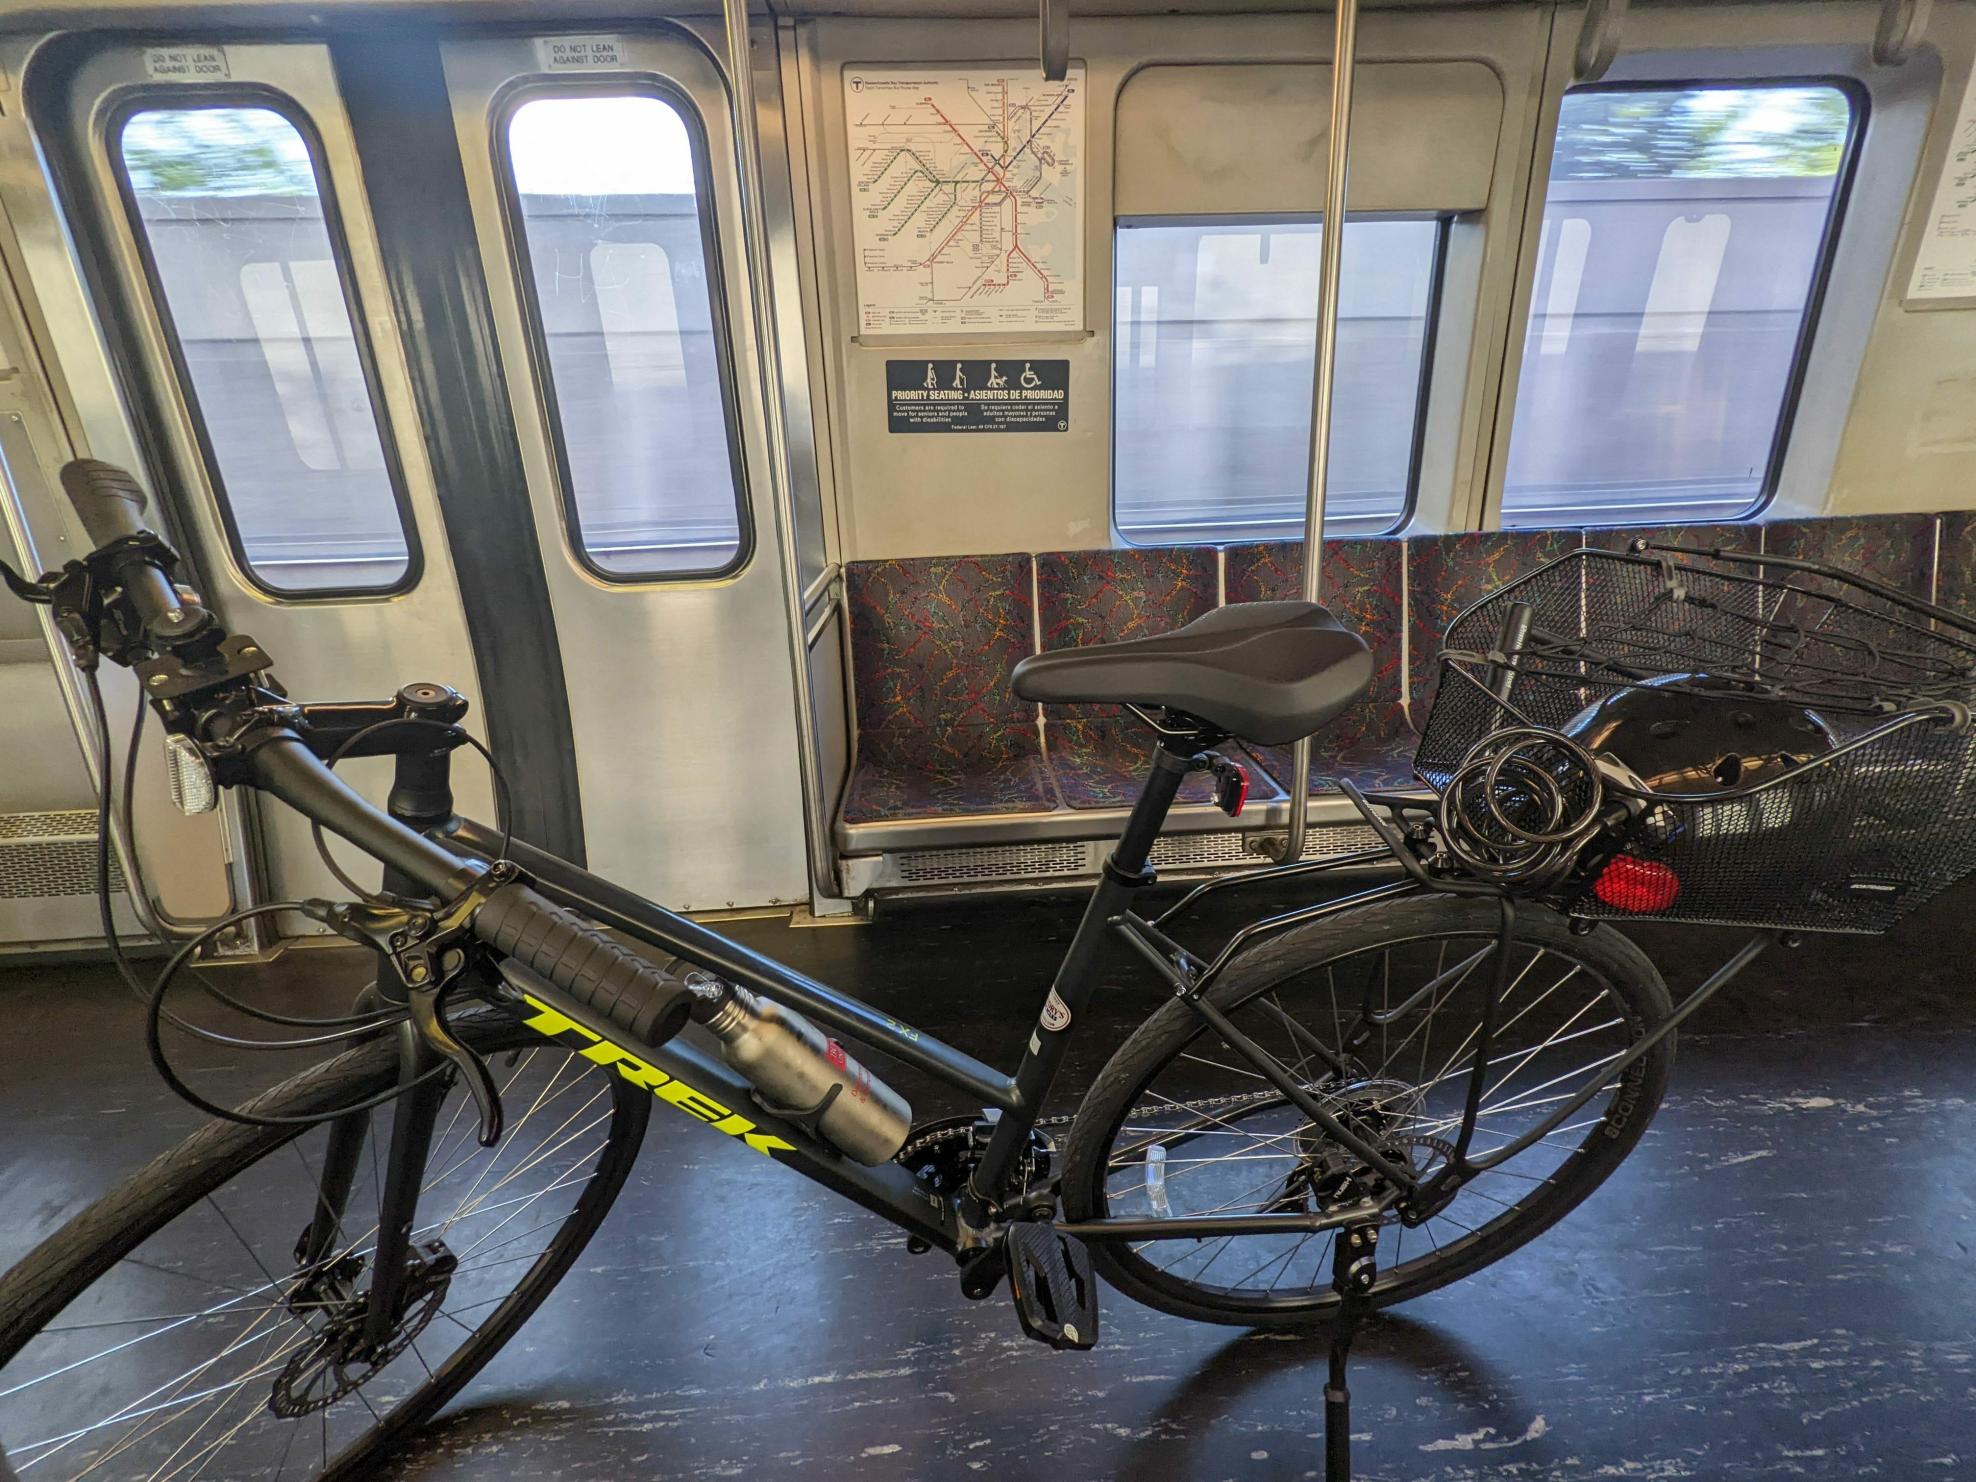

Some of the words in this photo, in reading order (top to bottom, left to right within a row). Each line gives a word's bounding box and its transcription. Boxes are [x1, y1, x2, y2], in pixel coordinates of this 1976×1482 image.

[553, 44, 566, 54] DO
[569, 44, 587, 53] NOT
[591, 43, 614, 53] LEAN
[152, 54, 166, 63] DO
[168, 54, 187, 63] NOT
[192, 53, 217, 63] LEAN
[553, 55, 589, 64] AGAINST
[592, 54, 618, 64] DOOR
[153, 64, 190, 74] AGAINST
[194, 64, 222, 74] DOOR
[892, 390, 928, 400] PRIORITY
[929, 390, 963, 400] SEATING
[969, 390, 1009, 399] ASIENTOS
[1010, 390, 1020, 399] DE
[1022, 389, 1064, 399] PRIORIDAD
[900, 1024, 919, 1041] FX
[522, 993, 797, 1157] TREK
